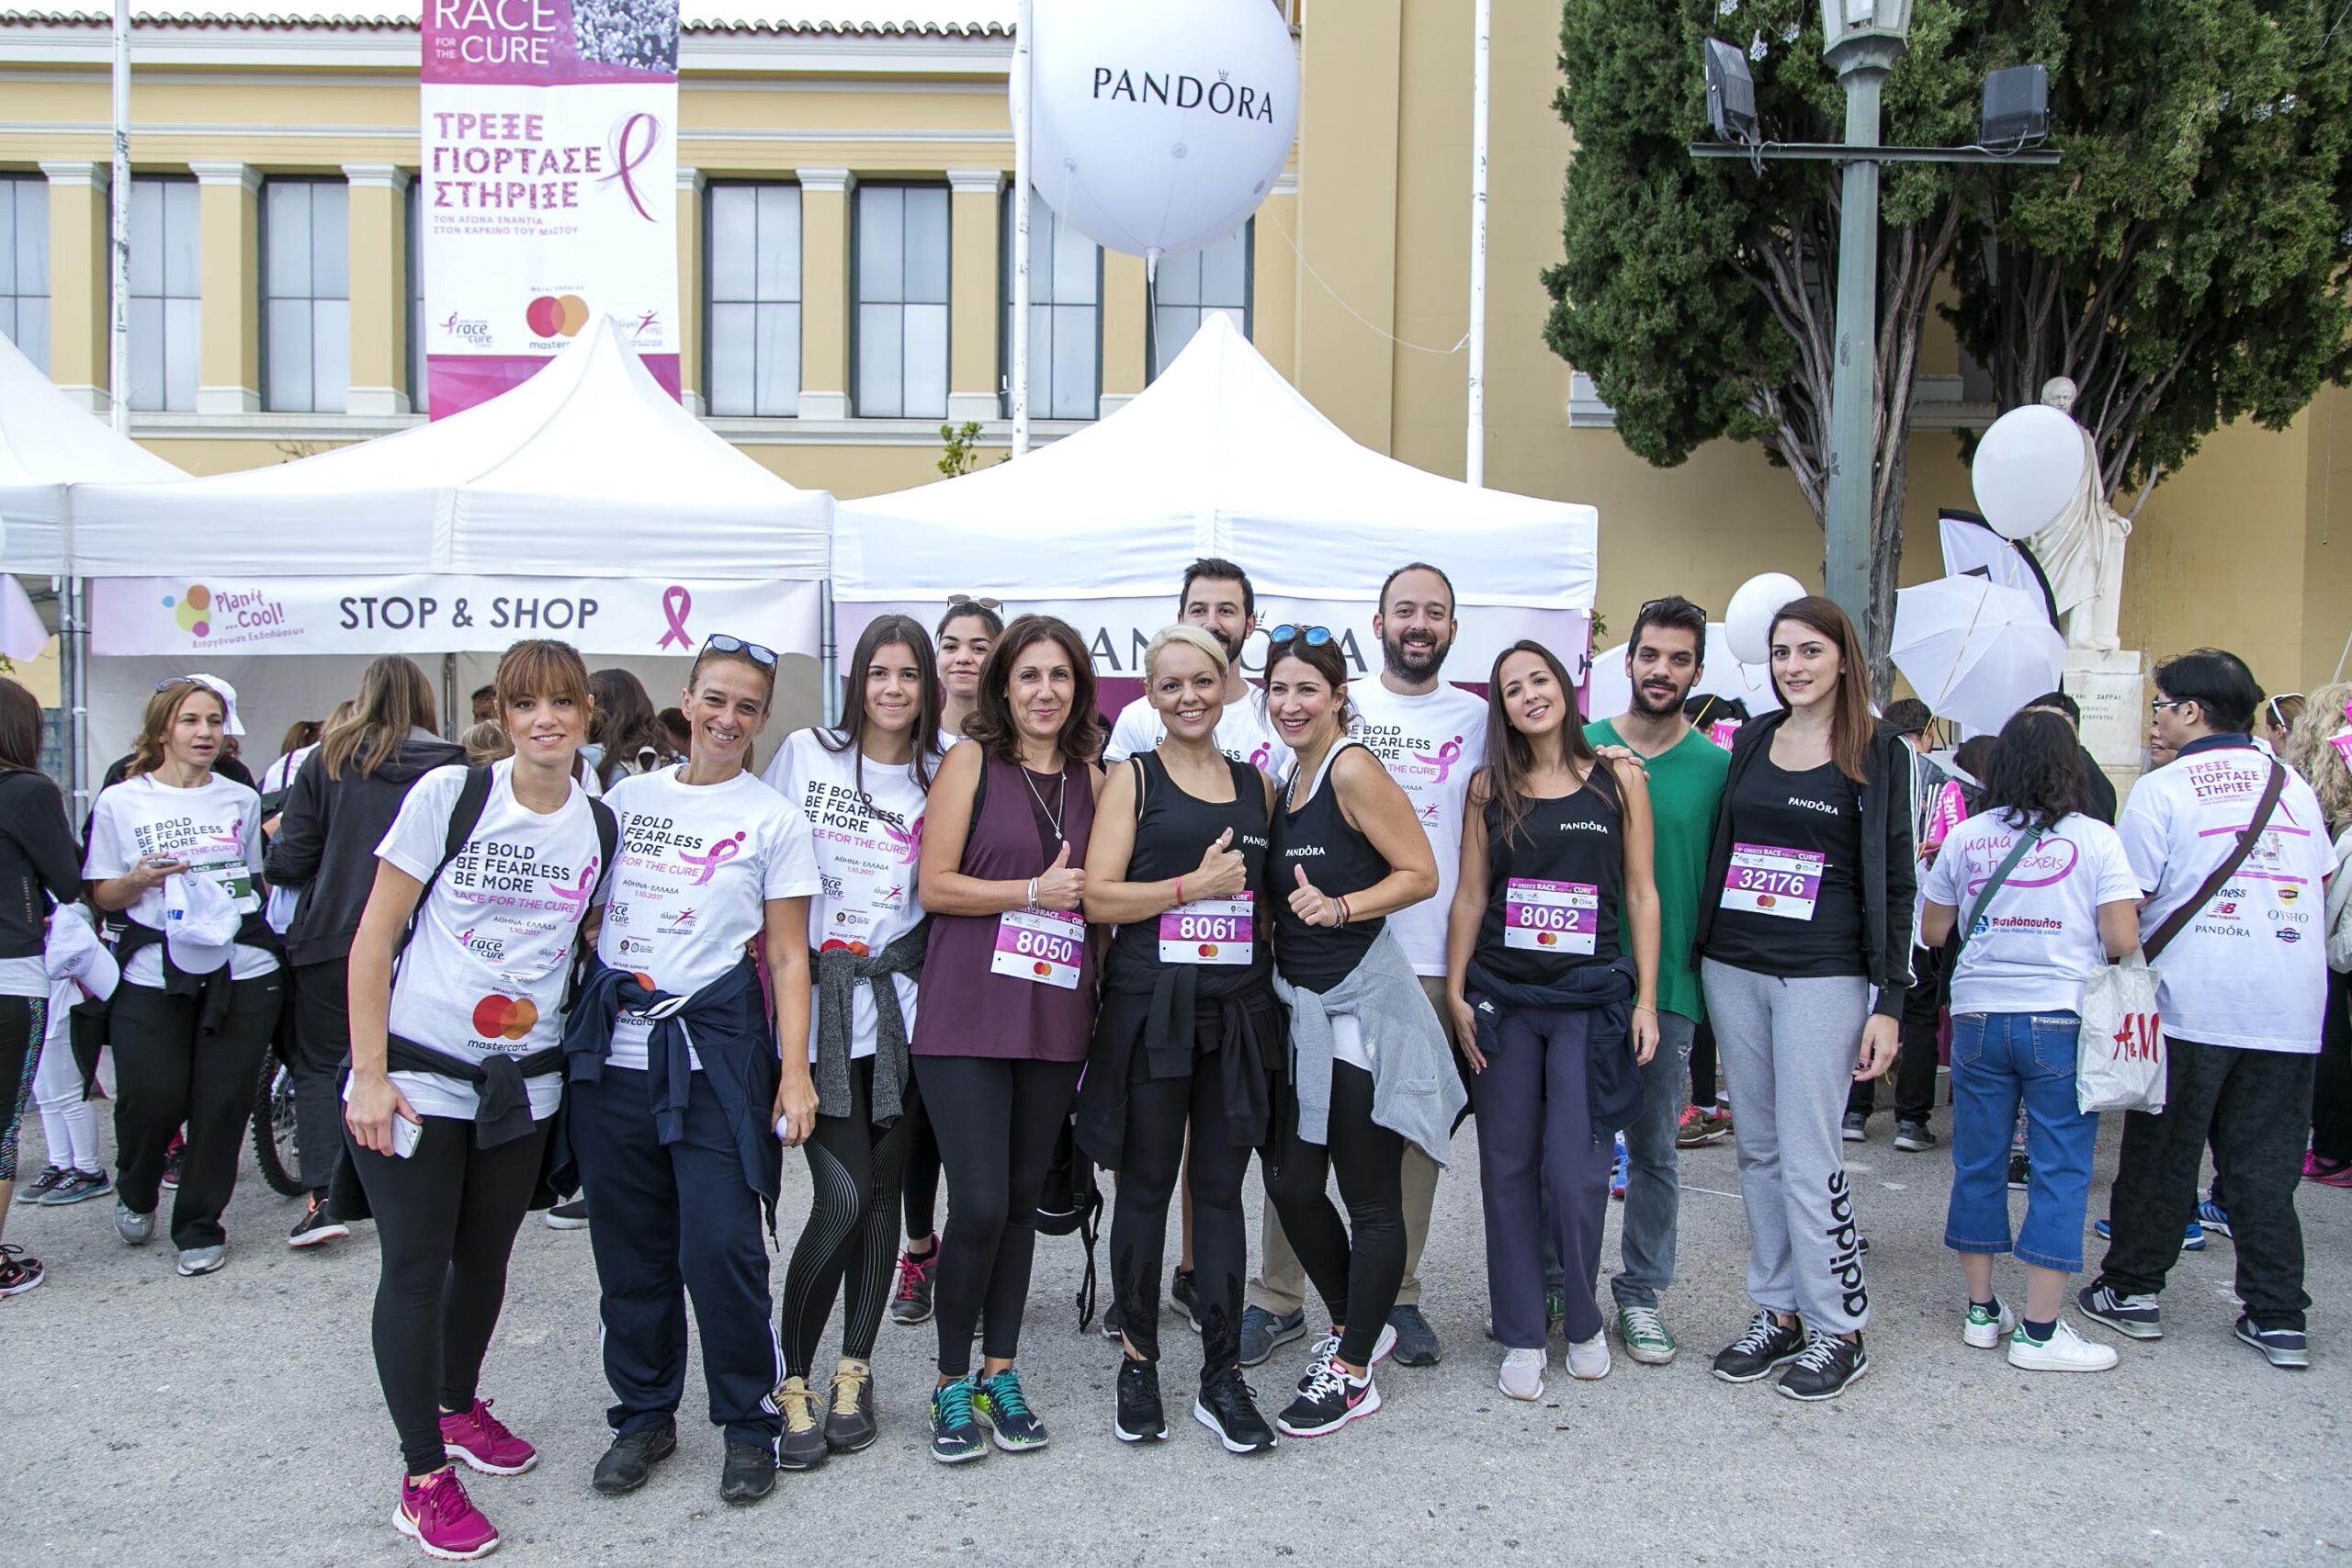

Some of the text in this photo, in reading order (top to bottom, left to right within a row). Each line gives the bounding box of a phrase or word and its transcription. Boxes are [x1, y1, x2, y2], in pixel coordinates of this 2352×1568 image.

[434, 0, 557, 31] RACE
[435, 38, 457, 47] FOR
[460, 35, 550, 64] CURE
[435, 50, 457, 59] THE
[1092, 66, 1273, 124] PANDORA
[434, 112, 544, 141] ΤΡΕΞΕ
[434, 147, 603, 175] ΓΙΟΡΤΑΣΕ
[434, 181, 579, 209] ΣΤΗΡΙΞΕ
[434, 215, 456, 223] ΤΟΝ
[497, 216, 544, 225] ΕΝΑΝΤΙΑ
[434, 225, 461, 234] ΣΤΟΝ
[464, 225, 511, 234] ΚΑΡΚΙΝΟ
[514, 226, 535, 235] ΤΟΥ
[457, 321, 488, 334] race
[469, 334, 493, 344] cure
[340, 596, 599, 629] STOP & SHOP
[1363, 725, 1401, 736] BOLD
[1362, 736, 1431, 750] FEARLESS
[1387, 763, 1437, 776] THE CURE
[2185, 761, 2233, 775] ΤΡΕΞΕ
[2190, 771, 2259, 786] ΓΙΟΡΤΑΣΕ
[808, 780, 873, 805] BE BOLD
[2195, 782, 2253, 797] ΣΤΗΡΙΞΕ
[805, 795, 905, 826] BE FEARLESS
[1787, 796, 1838, 816] PANDORA
[134, 817, 192, 838] BE BOLD
[631, 814, 673, 829] BOLD
[822, 812, 870, 833] MORE
[1560, 820, 1608, 834] PANDORA
[138, 825, 223, 849] BE FEARLESS
[159, 837, 198, 852] MORE
[625, 827, 703, 850] FEARLESS
[828, 830, 853, 844] FOR
[854, 837, 876, 850] THE
[877, 841, 907, 855] CURE
[190, 846, 210, 856] THE
[210, 843, 237, 853] CURE
[459, 840, 535, 860] BE BOLD
[1285, 845, 1326, 858] PANDORA
[1764, 848, 1782, 857] RACE
[1798, 852, 1818, 862] CURE
[456, 856, 570, 881] BE FEARLESS
[620, 855, 699, 877] FOR THE CURE
[847, 866, 875, 876] 1.10.2017
[454, 871, 534, 893] BE MORE
[1536, 883, 1556, 892] RACE
[1573, 886, 1592, 895] CURE
[1738, 868, 1805, 896] 32176
[635, 890, 663, 900] 1.10.2017
[488, 896, 515, 907] FOR
[518, 898, 542, 909] THE
[544, 901, 575, 914] CURE
[1039, 908, 1059, 919] RACE
[1520, 905, 1579, 931] 8062
[2267, 909, 2309, 923] OYSHO
[509, 927, 541, 937] 1.10.2017
[1180, 916, 1236, 940] 8061
[2195, 924, 2251, 937] PANDORA
[470, 938, 503, 953] race
[1016, 931, 1072, 963] 8050
[481, 950, 504, 961] cure
[467, 1039, 529, 1052] mastercard
[1826, 1169, 1869, 1317] adidas
